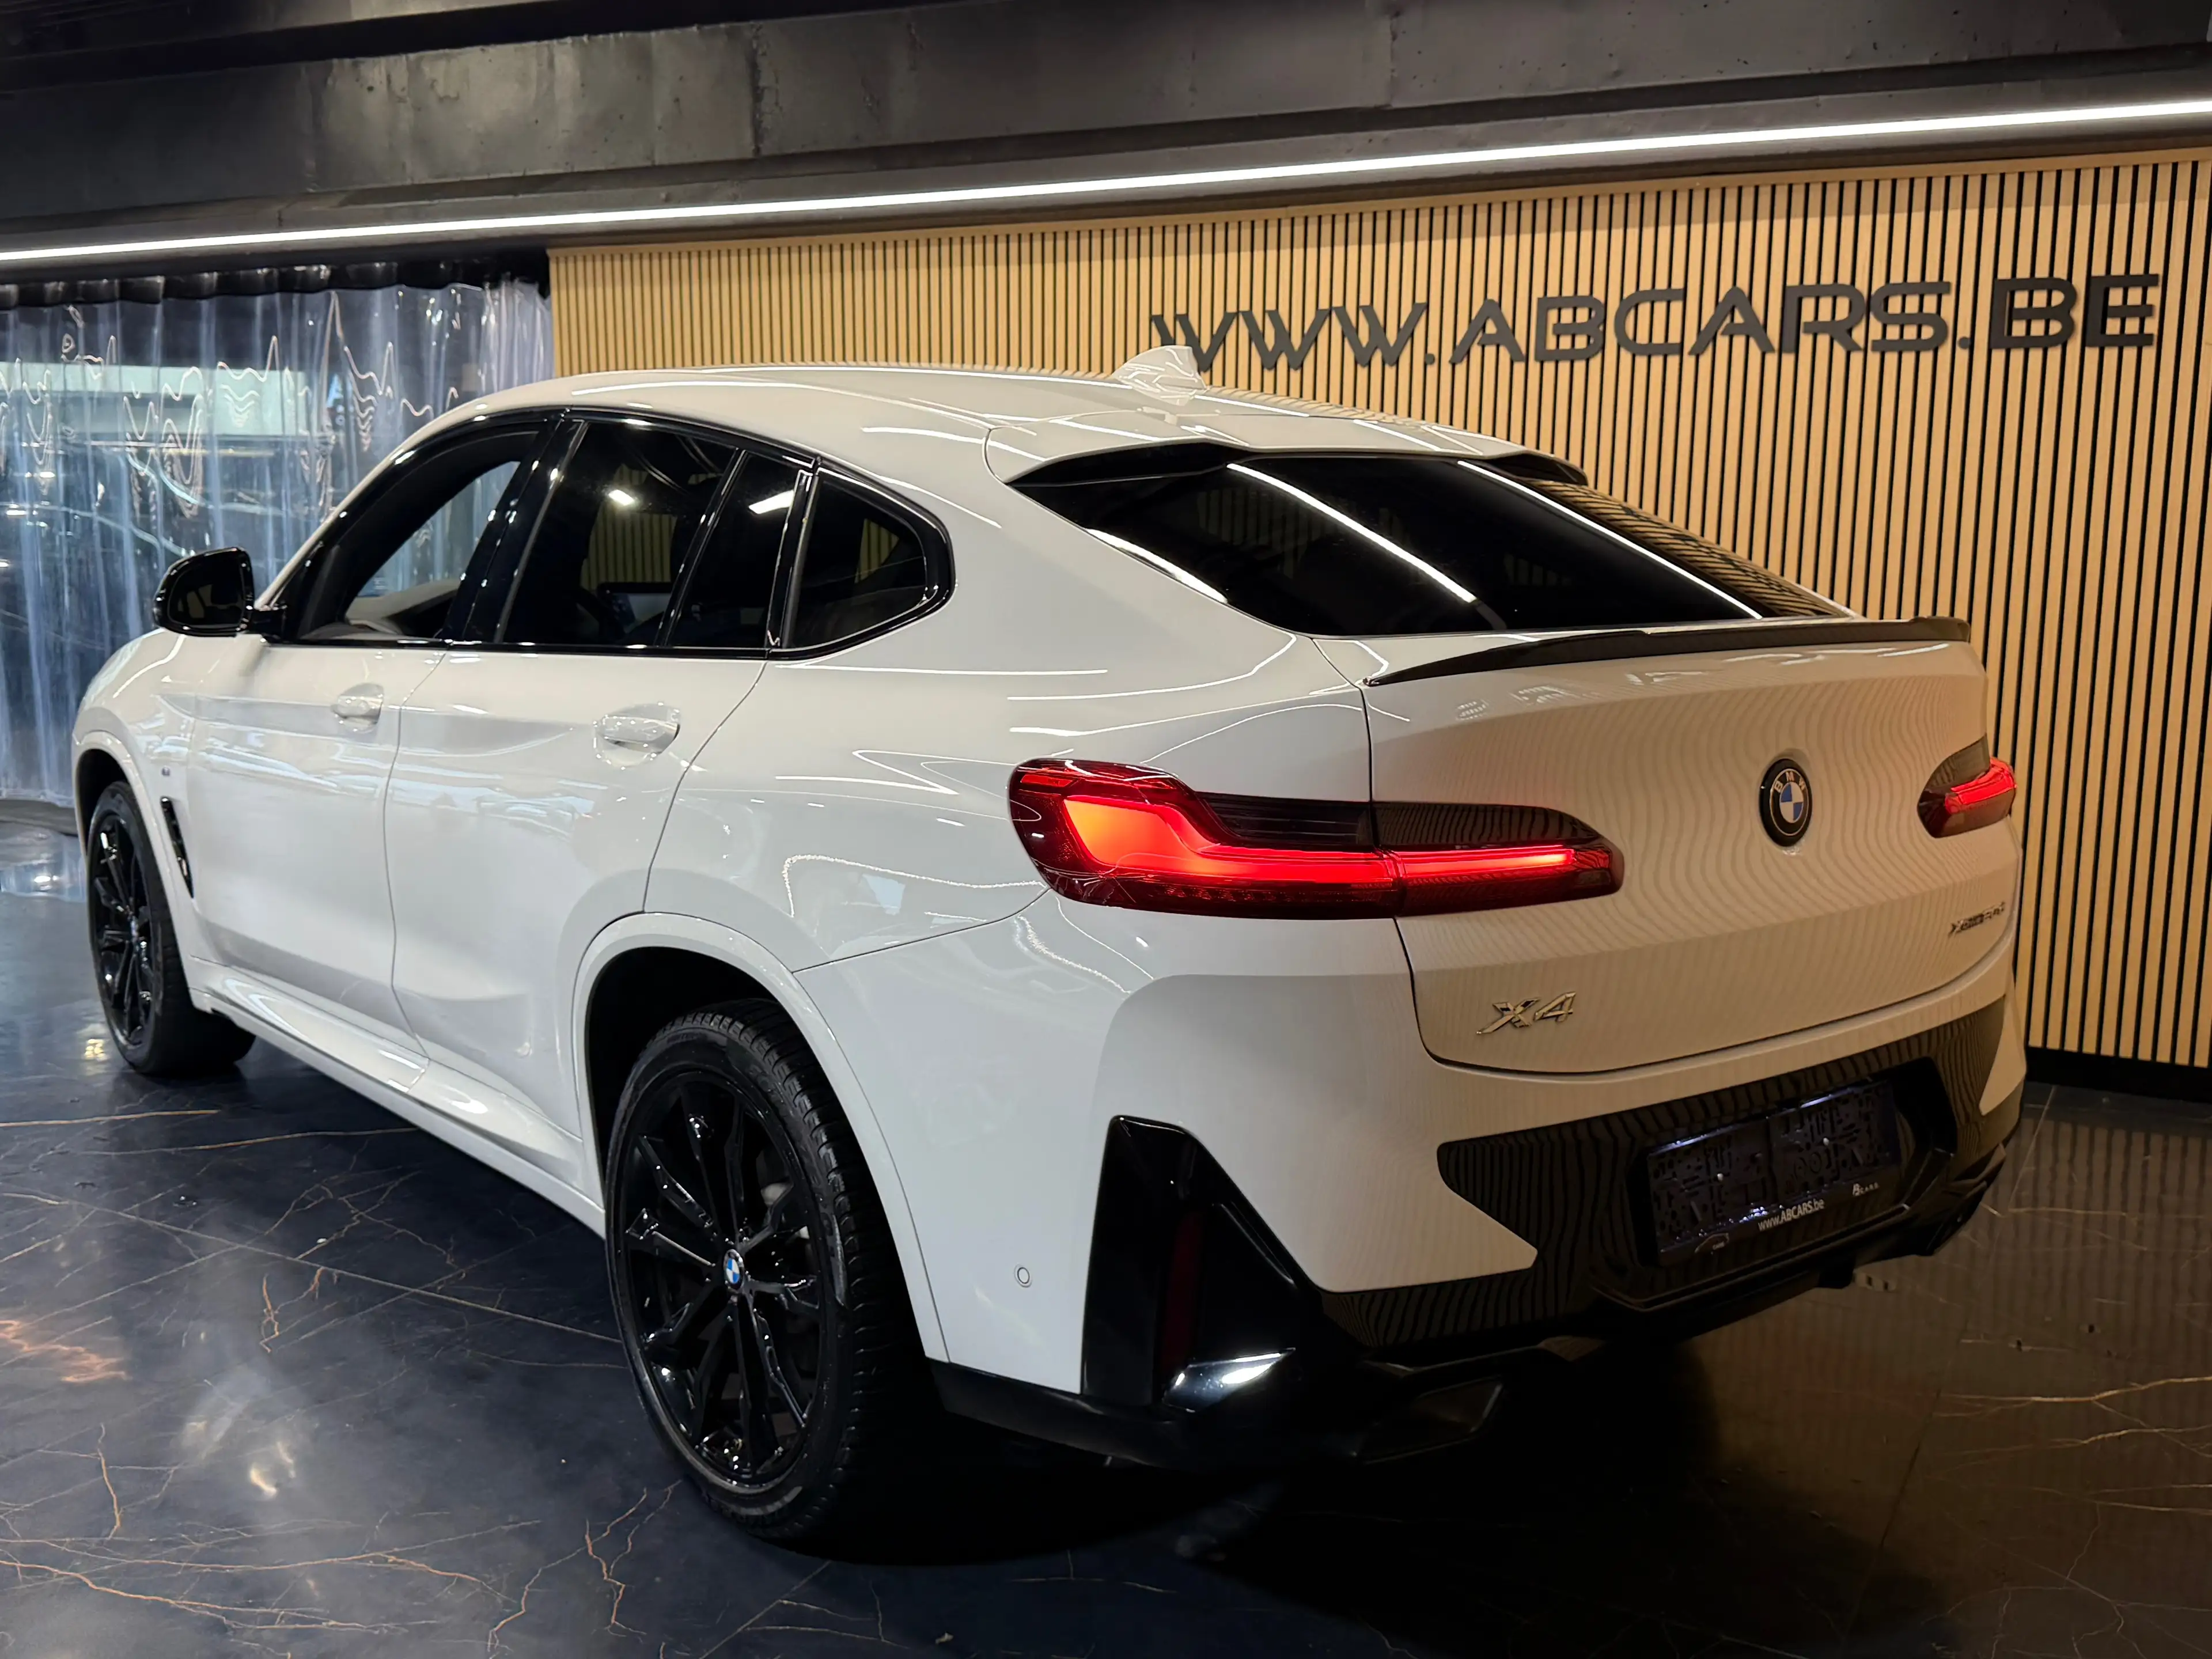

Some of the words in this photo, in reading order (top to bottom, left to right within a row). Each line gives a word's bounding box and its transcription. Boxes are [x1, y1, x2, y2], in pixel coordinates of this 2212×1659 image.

[1152, 274, 2160, 372] WWW.ABCARS.BE
[1774, 771, 1806, 793] BMW
[1475, 991, 1577, 1035] X4
[1758, 1198, 1825, 1232] www.ABCARS.be
